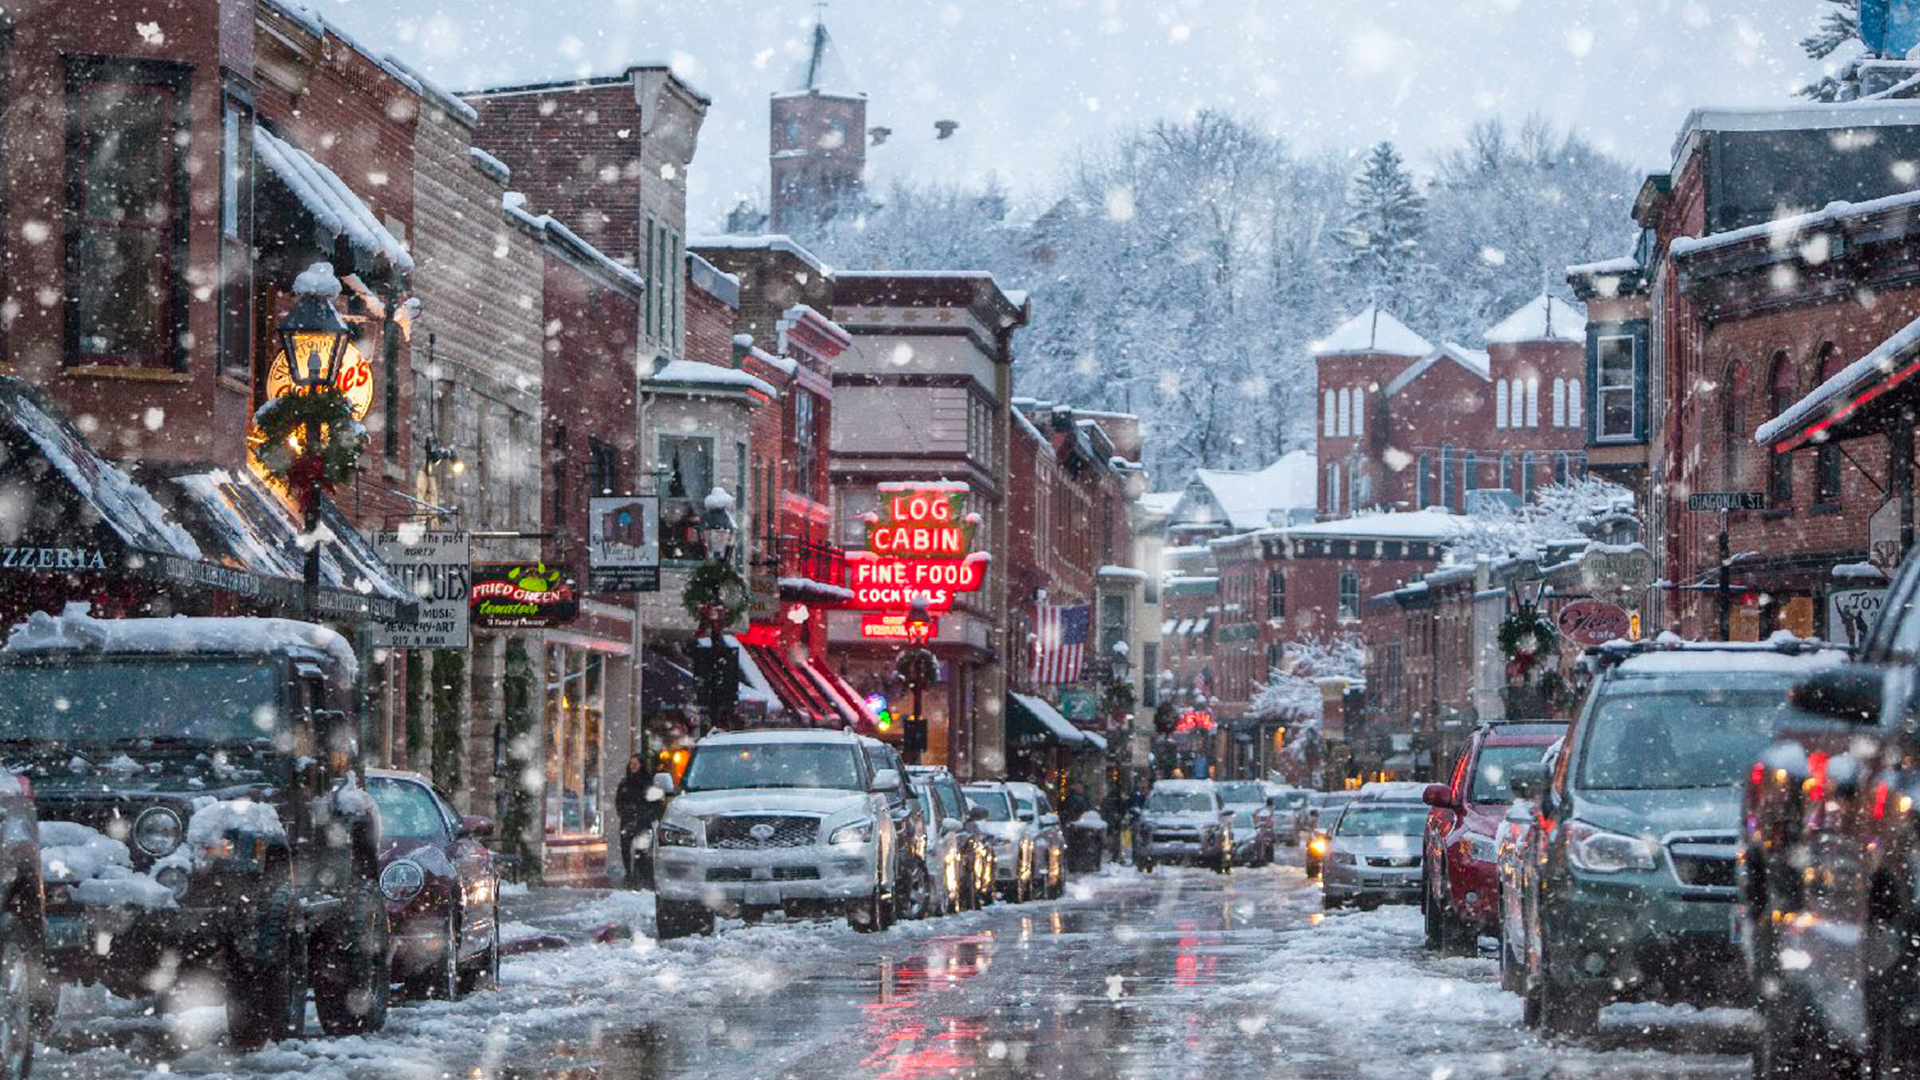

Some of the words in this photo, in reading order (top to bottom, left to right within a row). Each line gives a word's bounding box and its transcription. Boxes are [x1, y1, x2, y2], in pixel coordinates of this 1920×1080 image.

[893, 497, 949, 521] LOG
[1691, 494, 1742, 509] DIAGONAL
[874, 527, 958, 551] CABIN
[2, 547, 107, 569] ZZERIA
[404, 547, 436, 556] NORTH
[858, 564, 906, 584] FINE
[915, 564, 973, 584] FOOD
[473, 583, 514, 599] FRIED
[513, 589, 560, 602] GREEN
[858, 588, 947, 604] COCKTAILS
[423, 608, 456, 619] MUSIC
